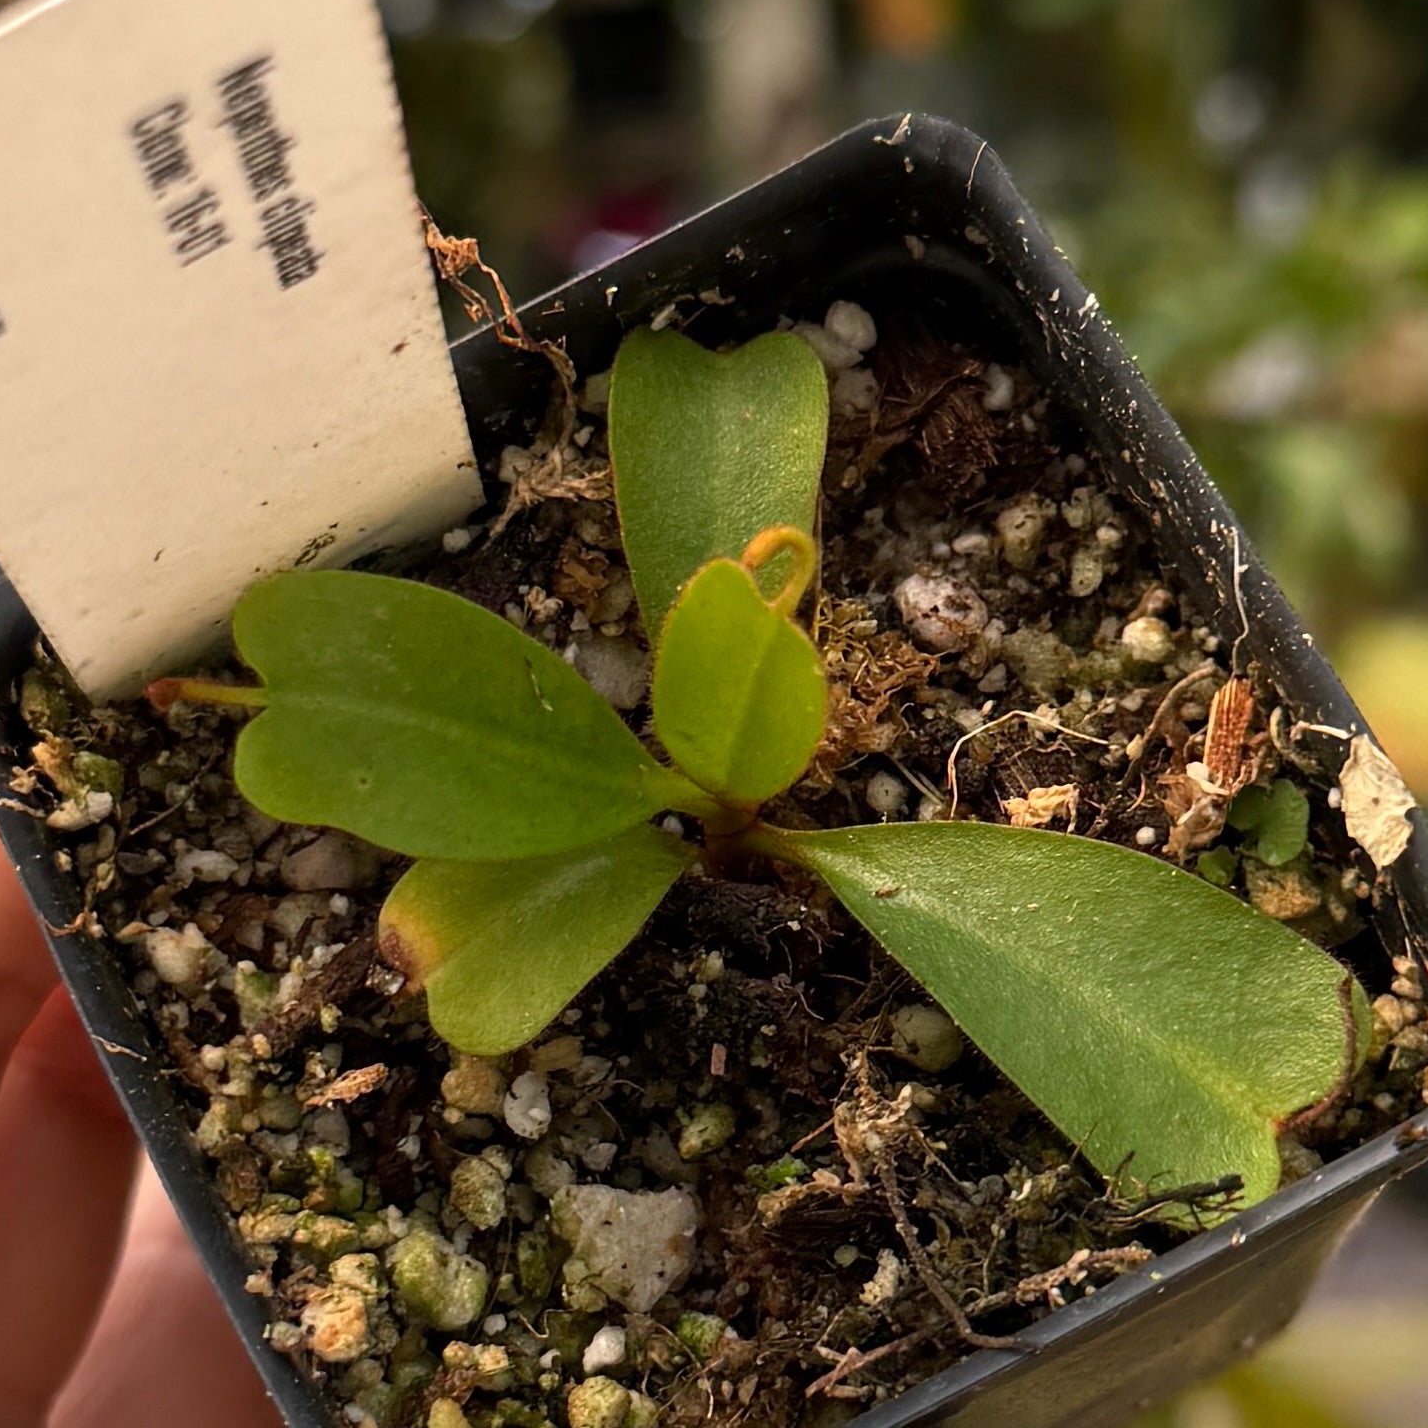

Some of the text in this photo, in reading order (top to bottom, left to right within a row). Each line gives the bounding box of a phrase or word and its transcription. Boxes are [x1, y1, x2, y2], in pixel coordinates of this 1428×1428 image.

[129, 99, 232, 268] Clone: 16-01
[216, 55, 326, 292] Nepenthes clipeata
